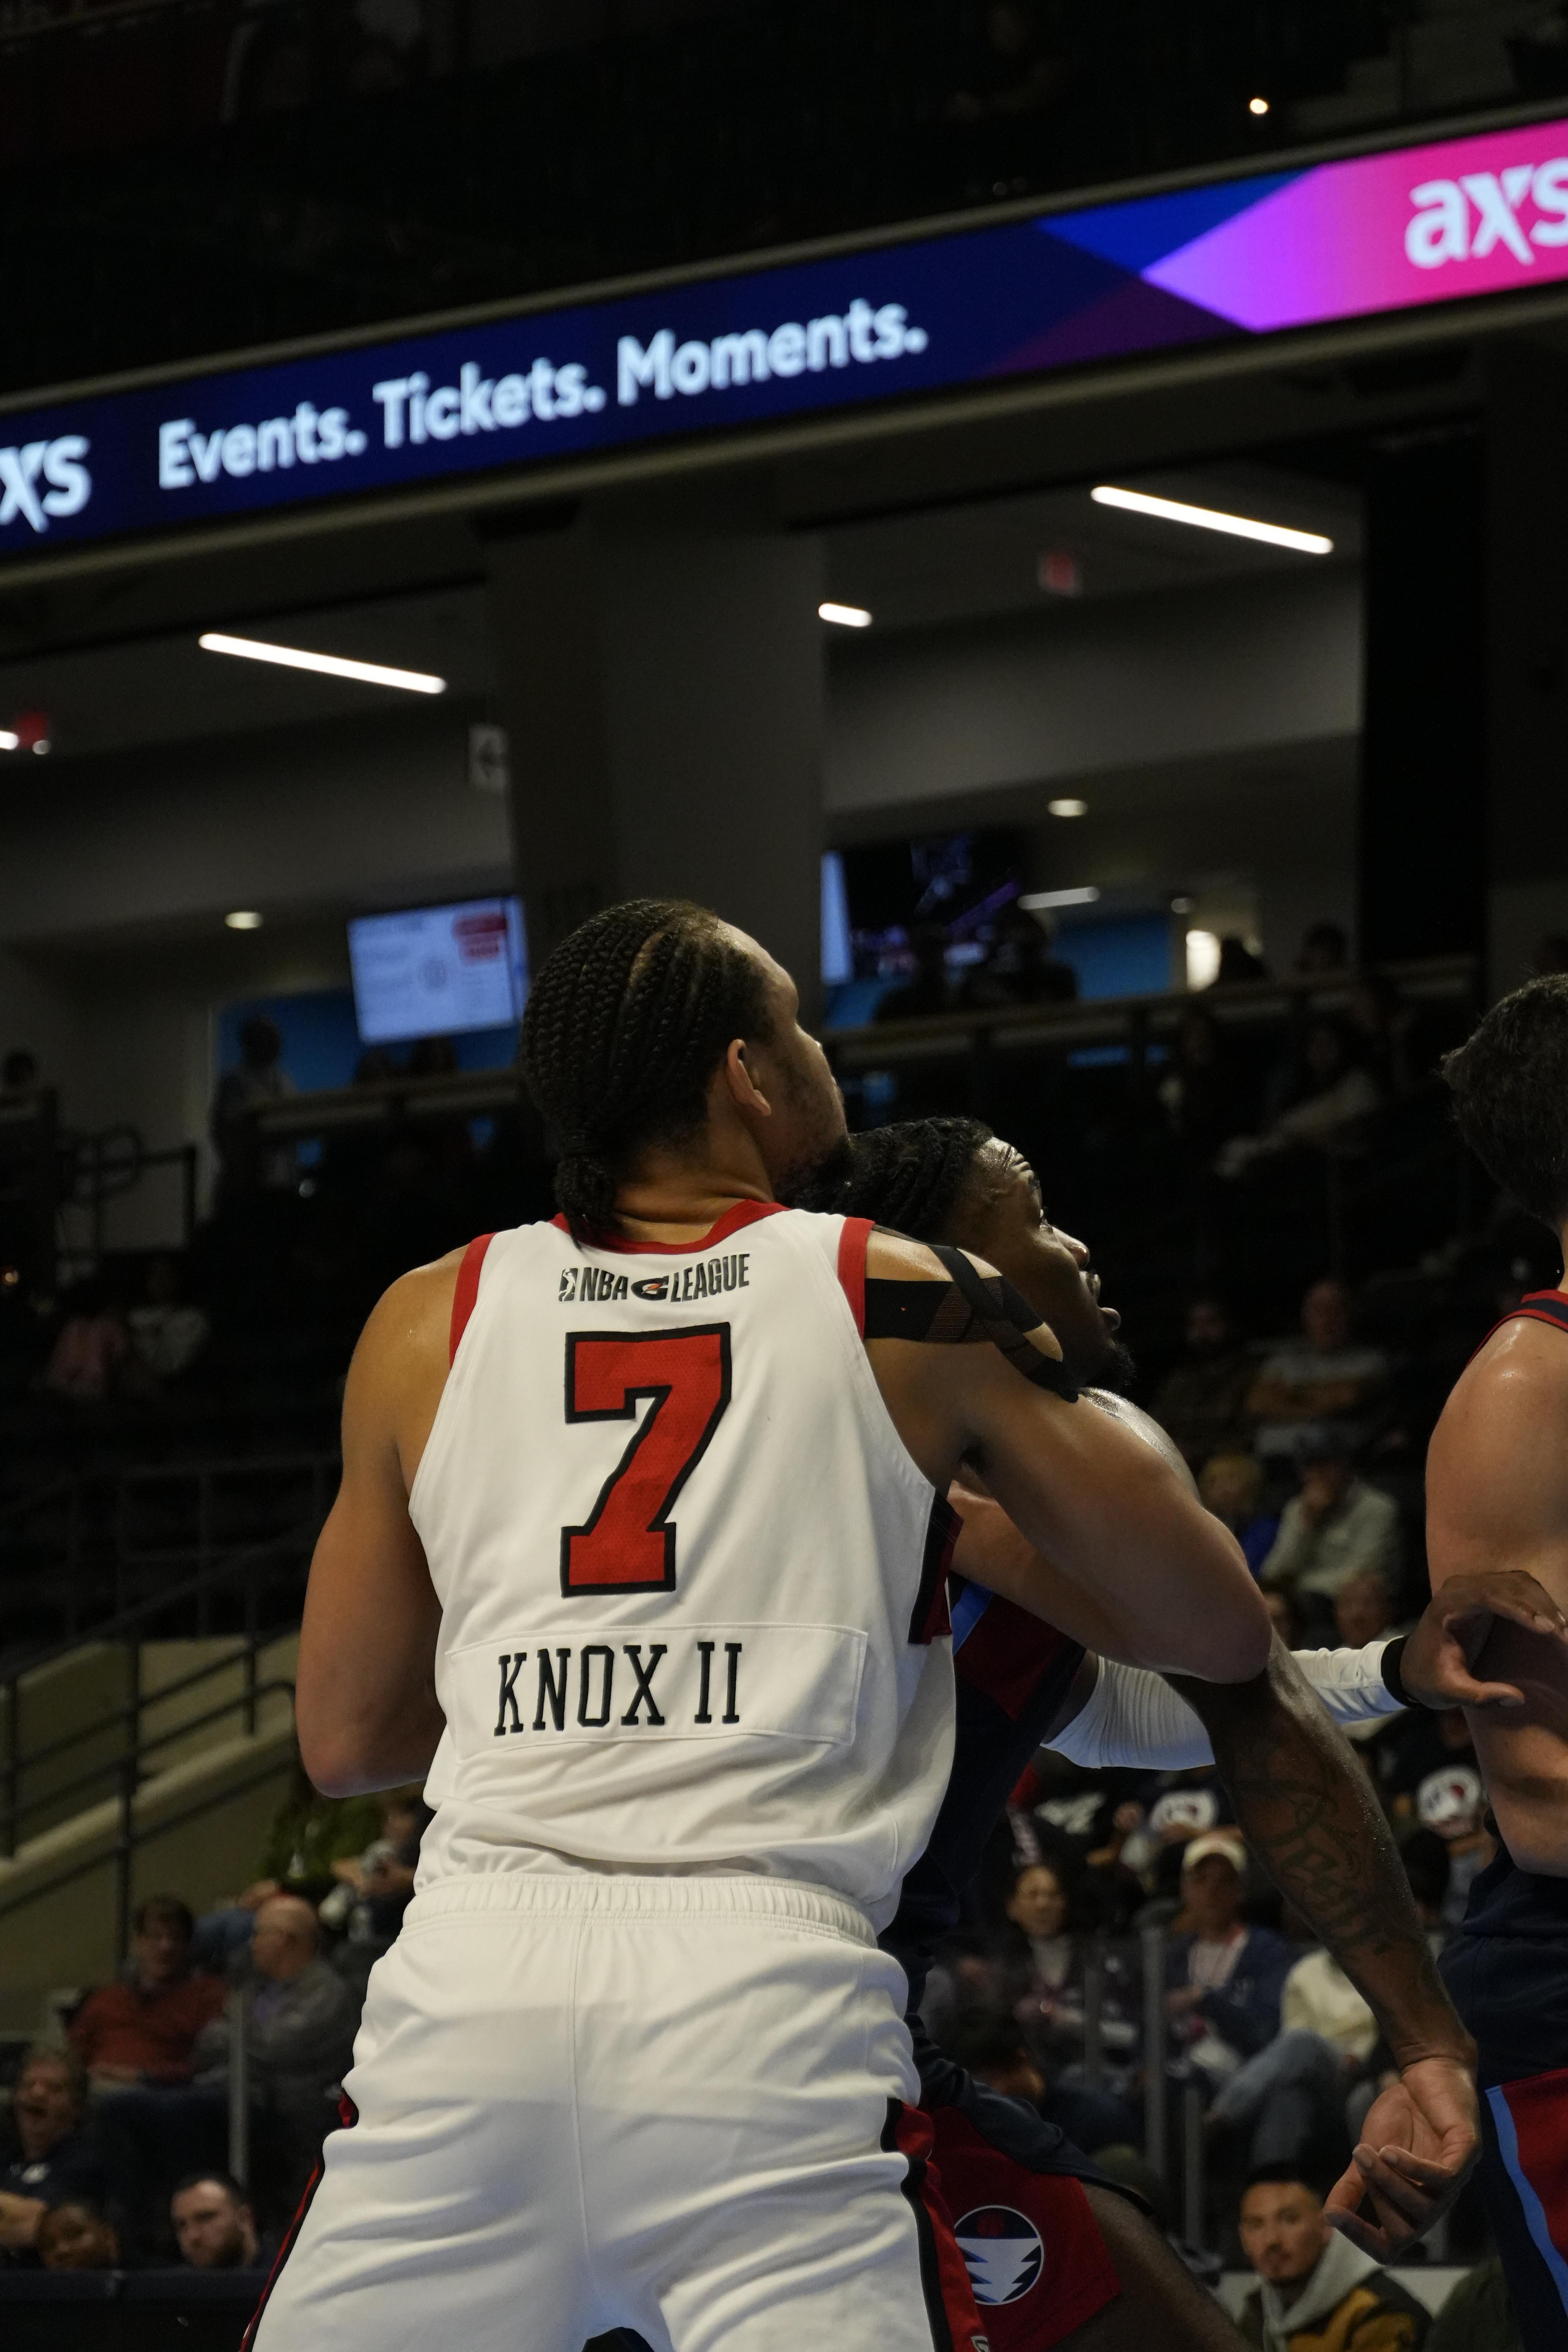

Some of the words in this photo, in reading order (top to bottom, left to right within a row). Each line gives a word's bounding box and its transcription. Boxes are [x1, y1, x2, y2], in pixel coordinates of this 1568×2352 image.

[1404, 157, 1568, 269] axs
[158, 405, 365, 488] Events.
[372, 360, 604, 447] Tickets.
[617, 300, 926, 404] Moments.
[580, 1267, 629, 1302] NBA
[670, 1253, 750, 1302] LEAGUE
[560, 1322, 732, 1598] 7
[494, 1644, 667, 1736] KNOX
[694, 1641, 742, 1724] II
